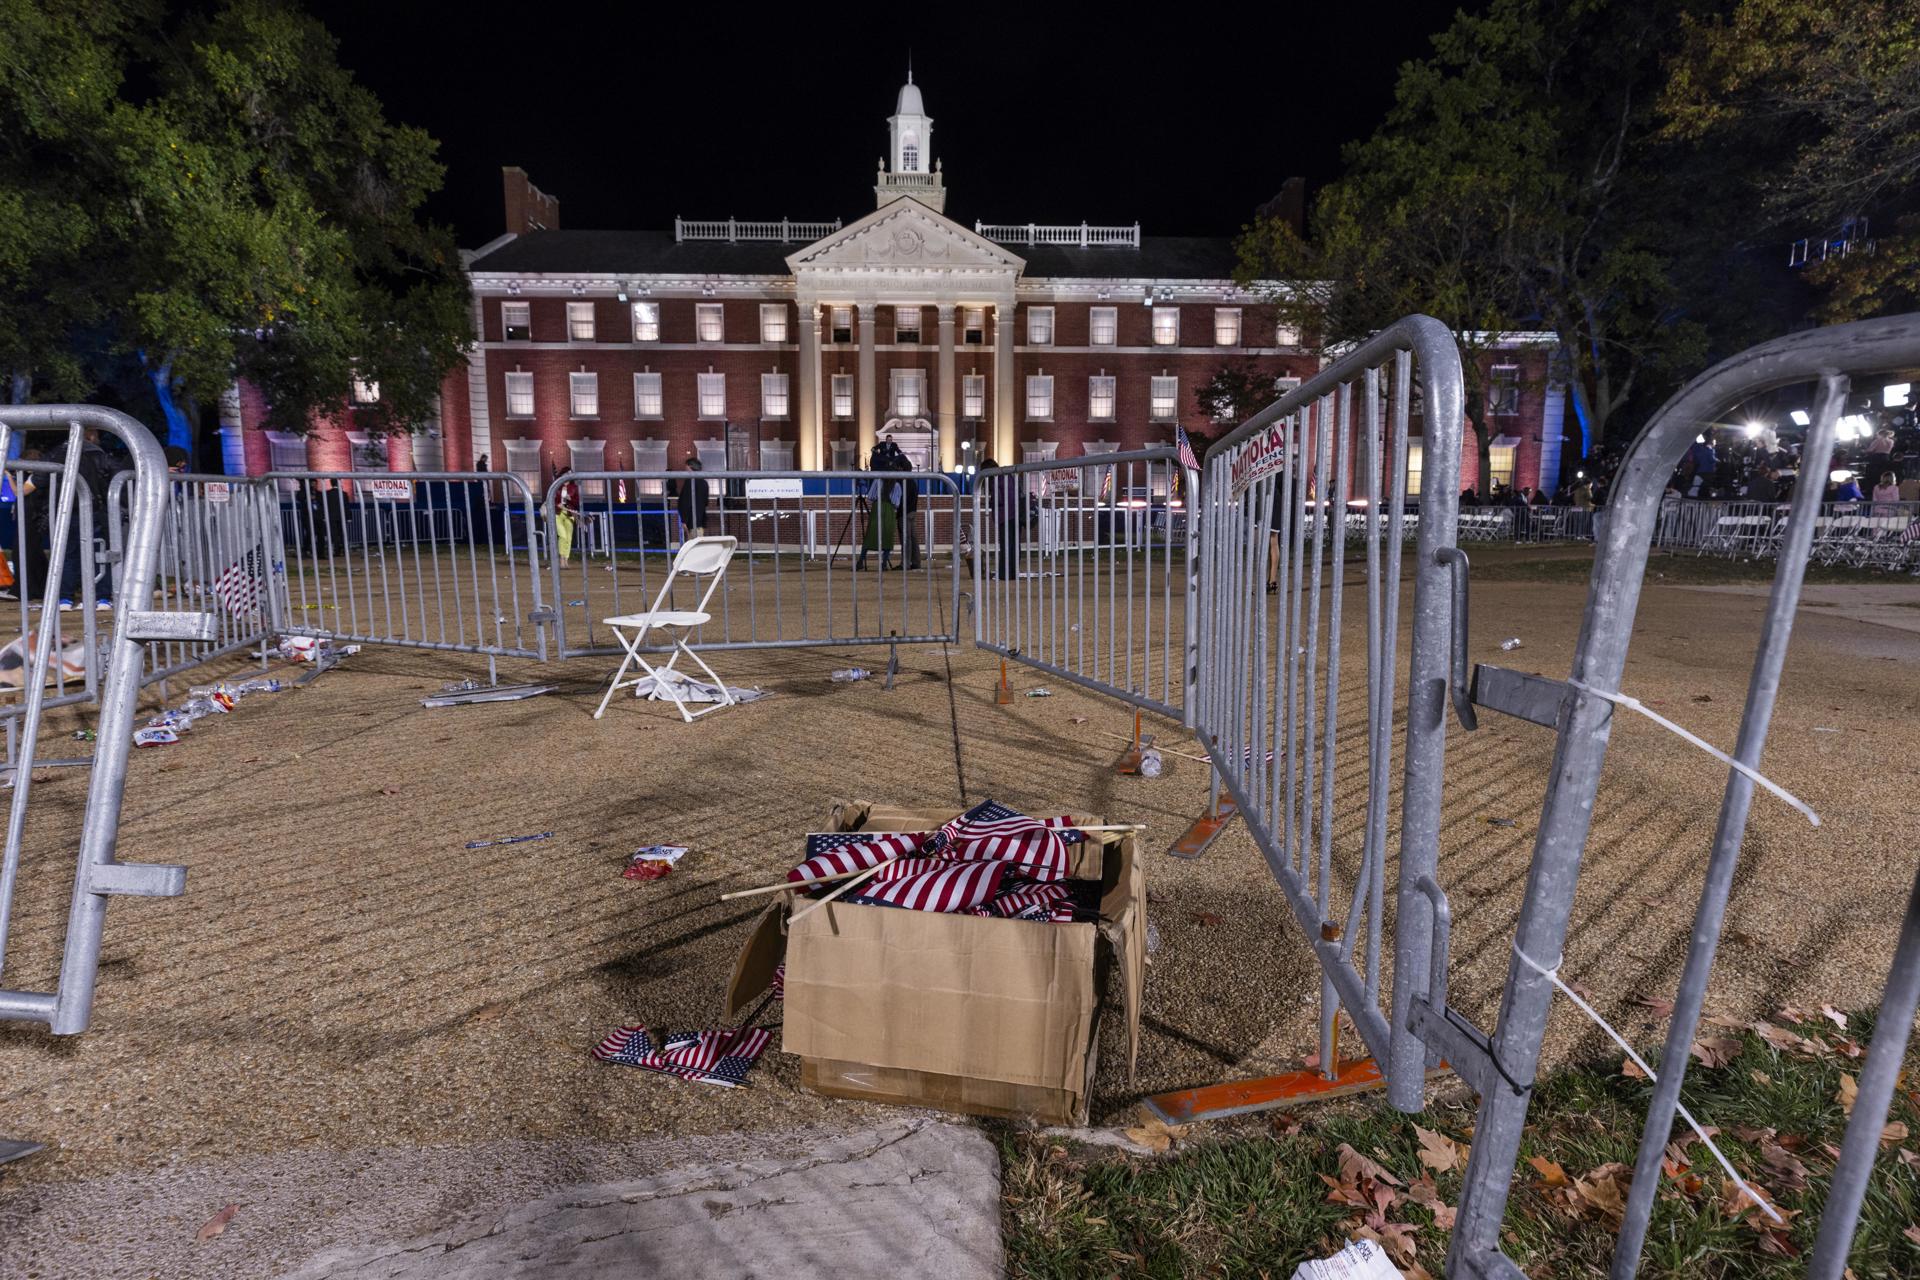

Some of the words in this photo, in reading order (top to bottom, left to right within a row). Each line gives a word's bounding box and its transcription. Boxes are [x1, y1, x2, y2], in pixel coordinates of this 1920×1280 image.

[973, 279, 992, 289] HALL
[1232, 422, 1286, 484] NATIONA
[1051, 468, 1077, 480] NATIONAL
[373, 480, 408, 490] NATIONAL
